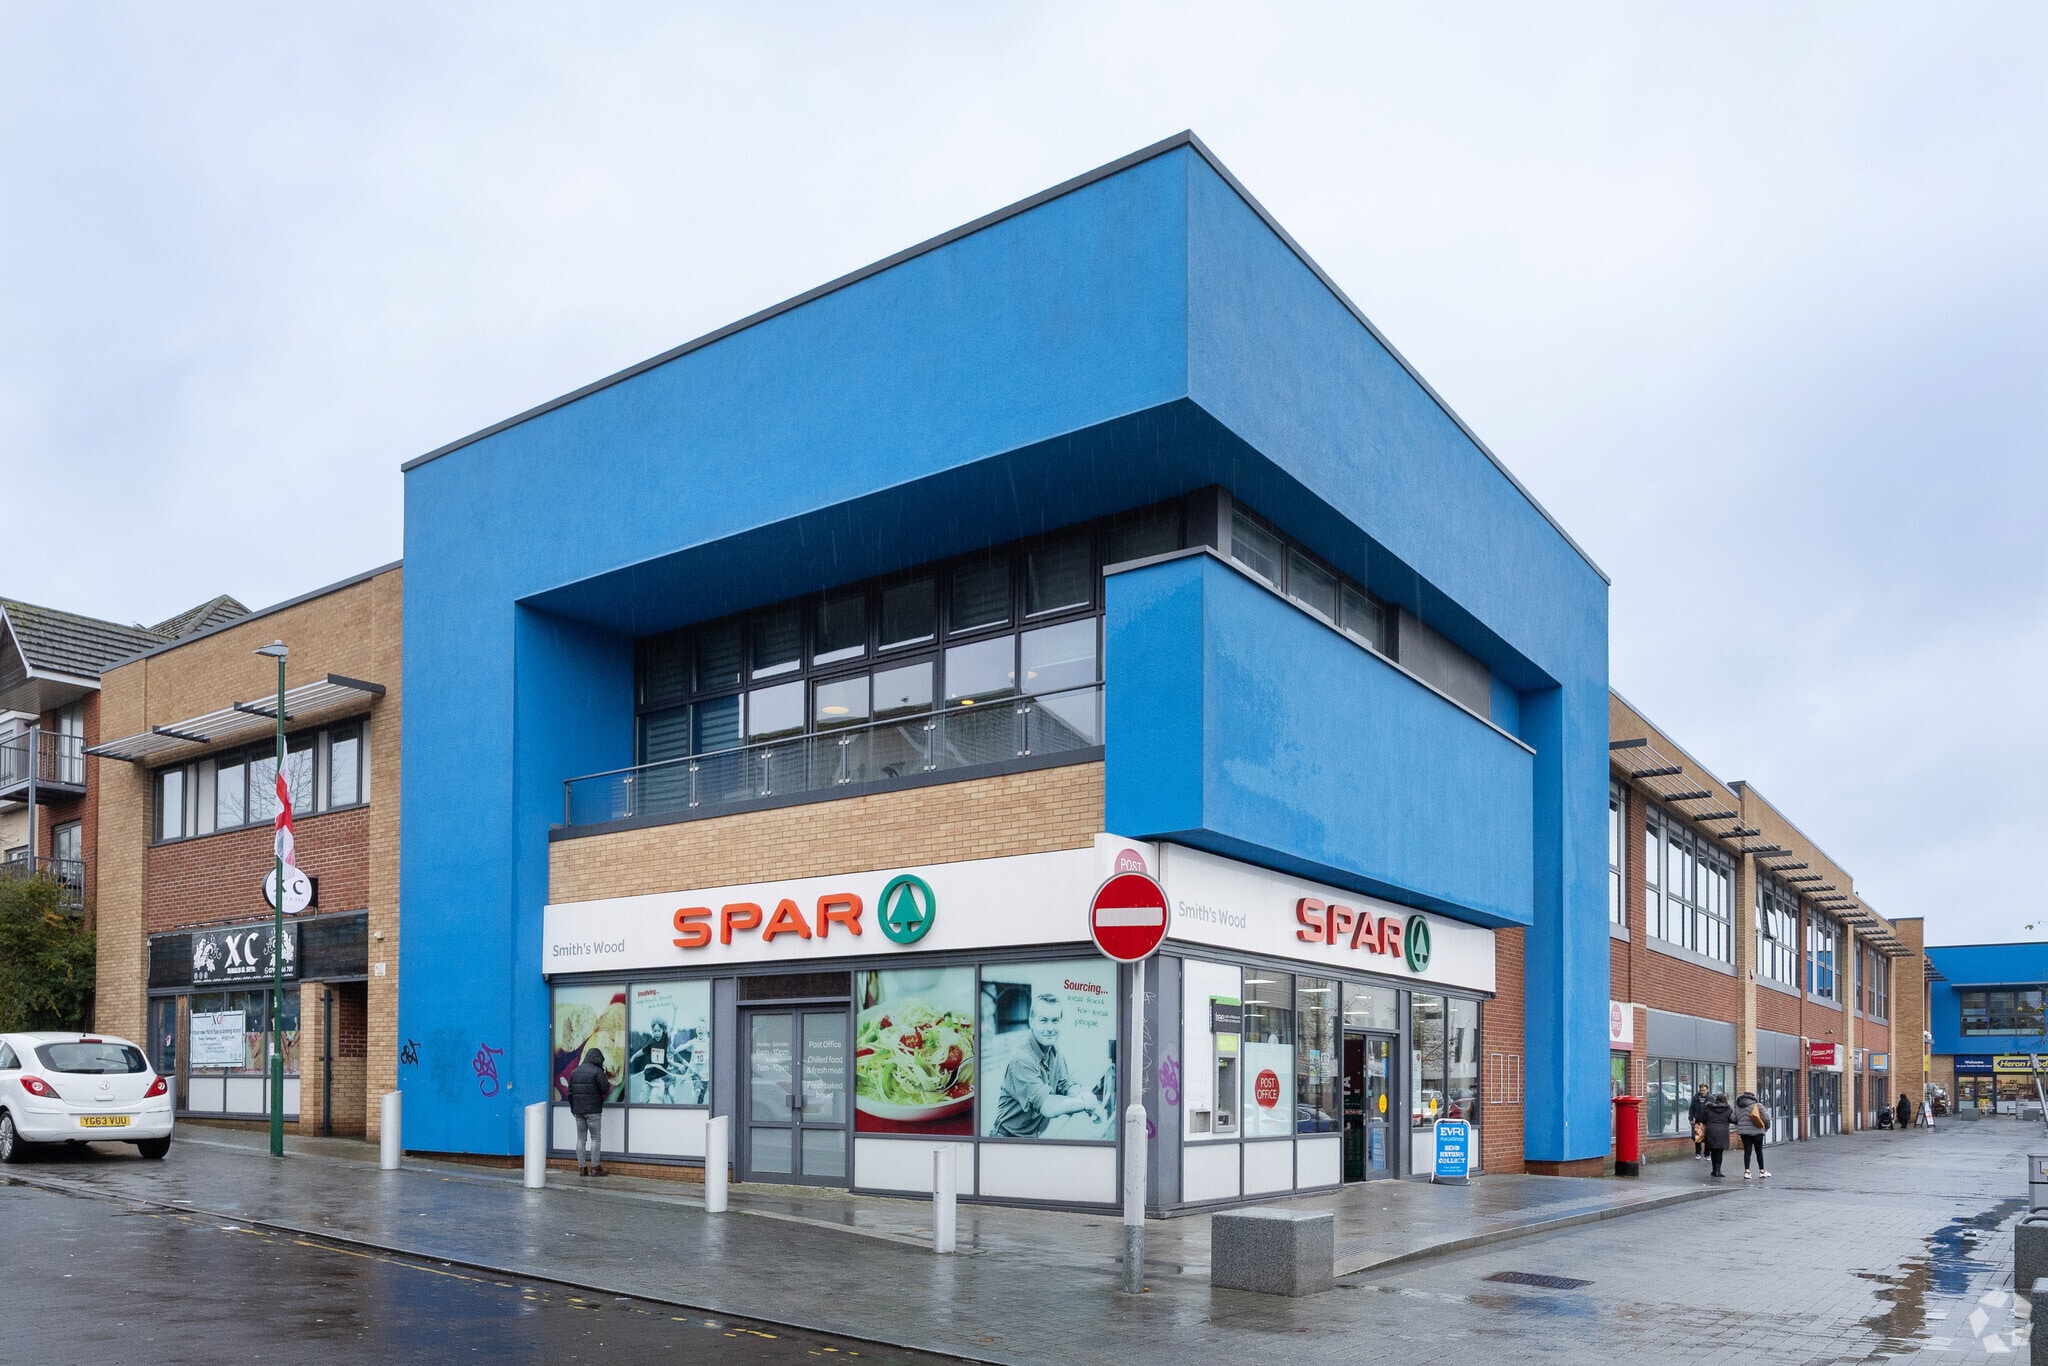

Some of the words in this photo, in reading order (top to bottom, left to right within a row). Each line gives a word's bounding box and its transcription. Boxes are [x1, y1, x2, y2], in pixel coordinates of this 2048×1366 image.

[1120, 858, 1142, 871] POST
[673, 892, 863, 948] SPAR
[1178, 901, 1217, 923] Smith's
[1218, 910, 1247, 929] Wood
[1296, 897, 1404, 957] SPAR
[224, 932, 259, 968] XC
[552, 942, 591, 957] Smith's
[593, 939, 625, 954] Wood
[1063, 979, 1109, 995] Sourcing...
[1260, 1077, 1275, 1088] POST
[1257, 1089, 1277, 1099] OFFICE
[83, 1116, 107, 1125] YG63
[109, 1115, 127, 1125] VUU
